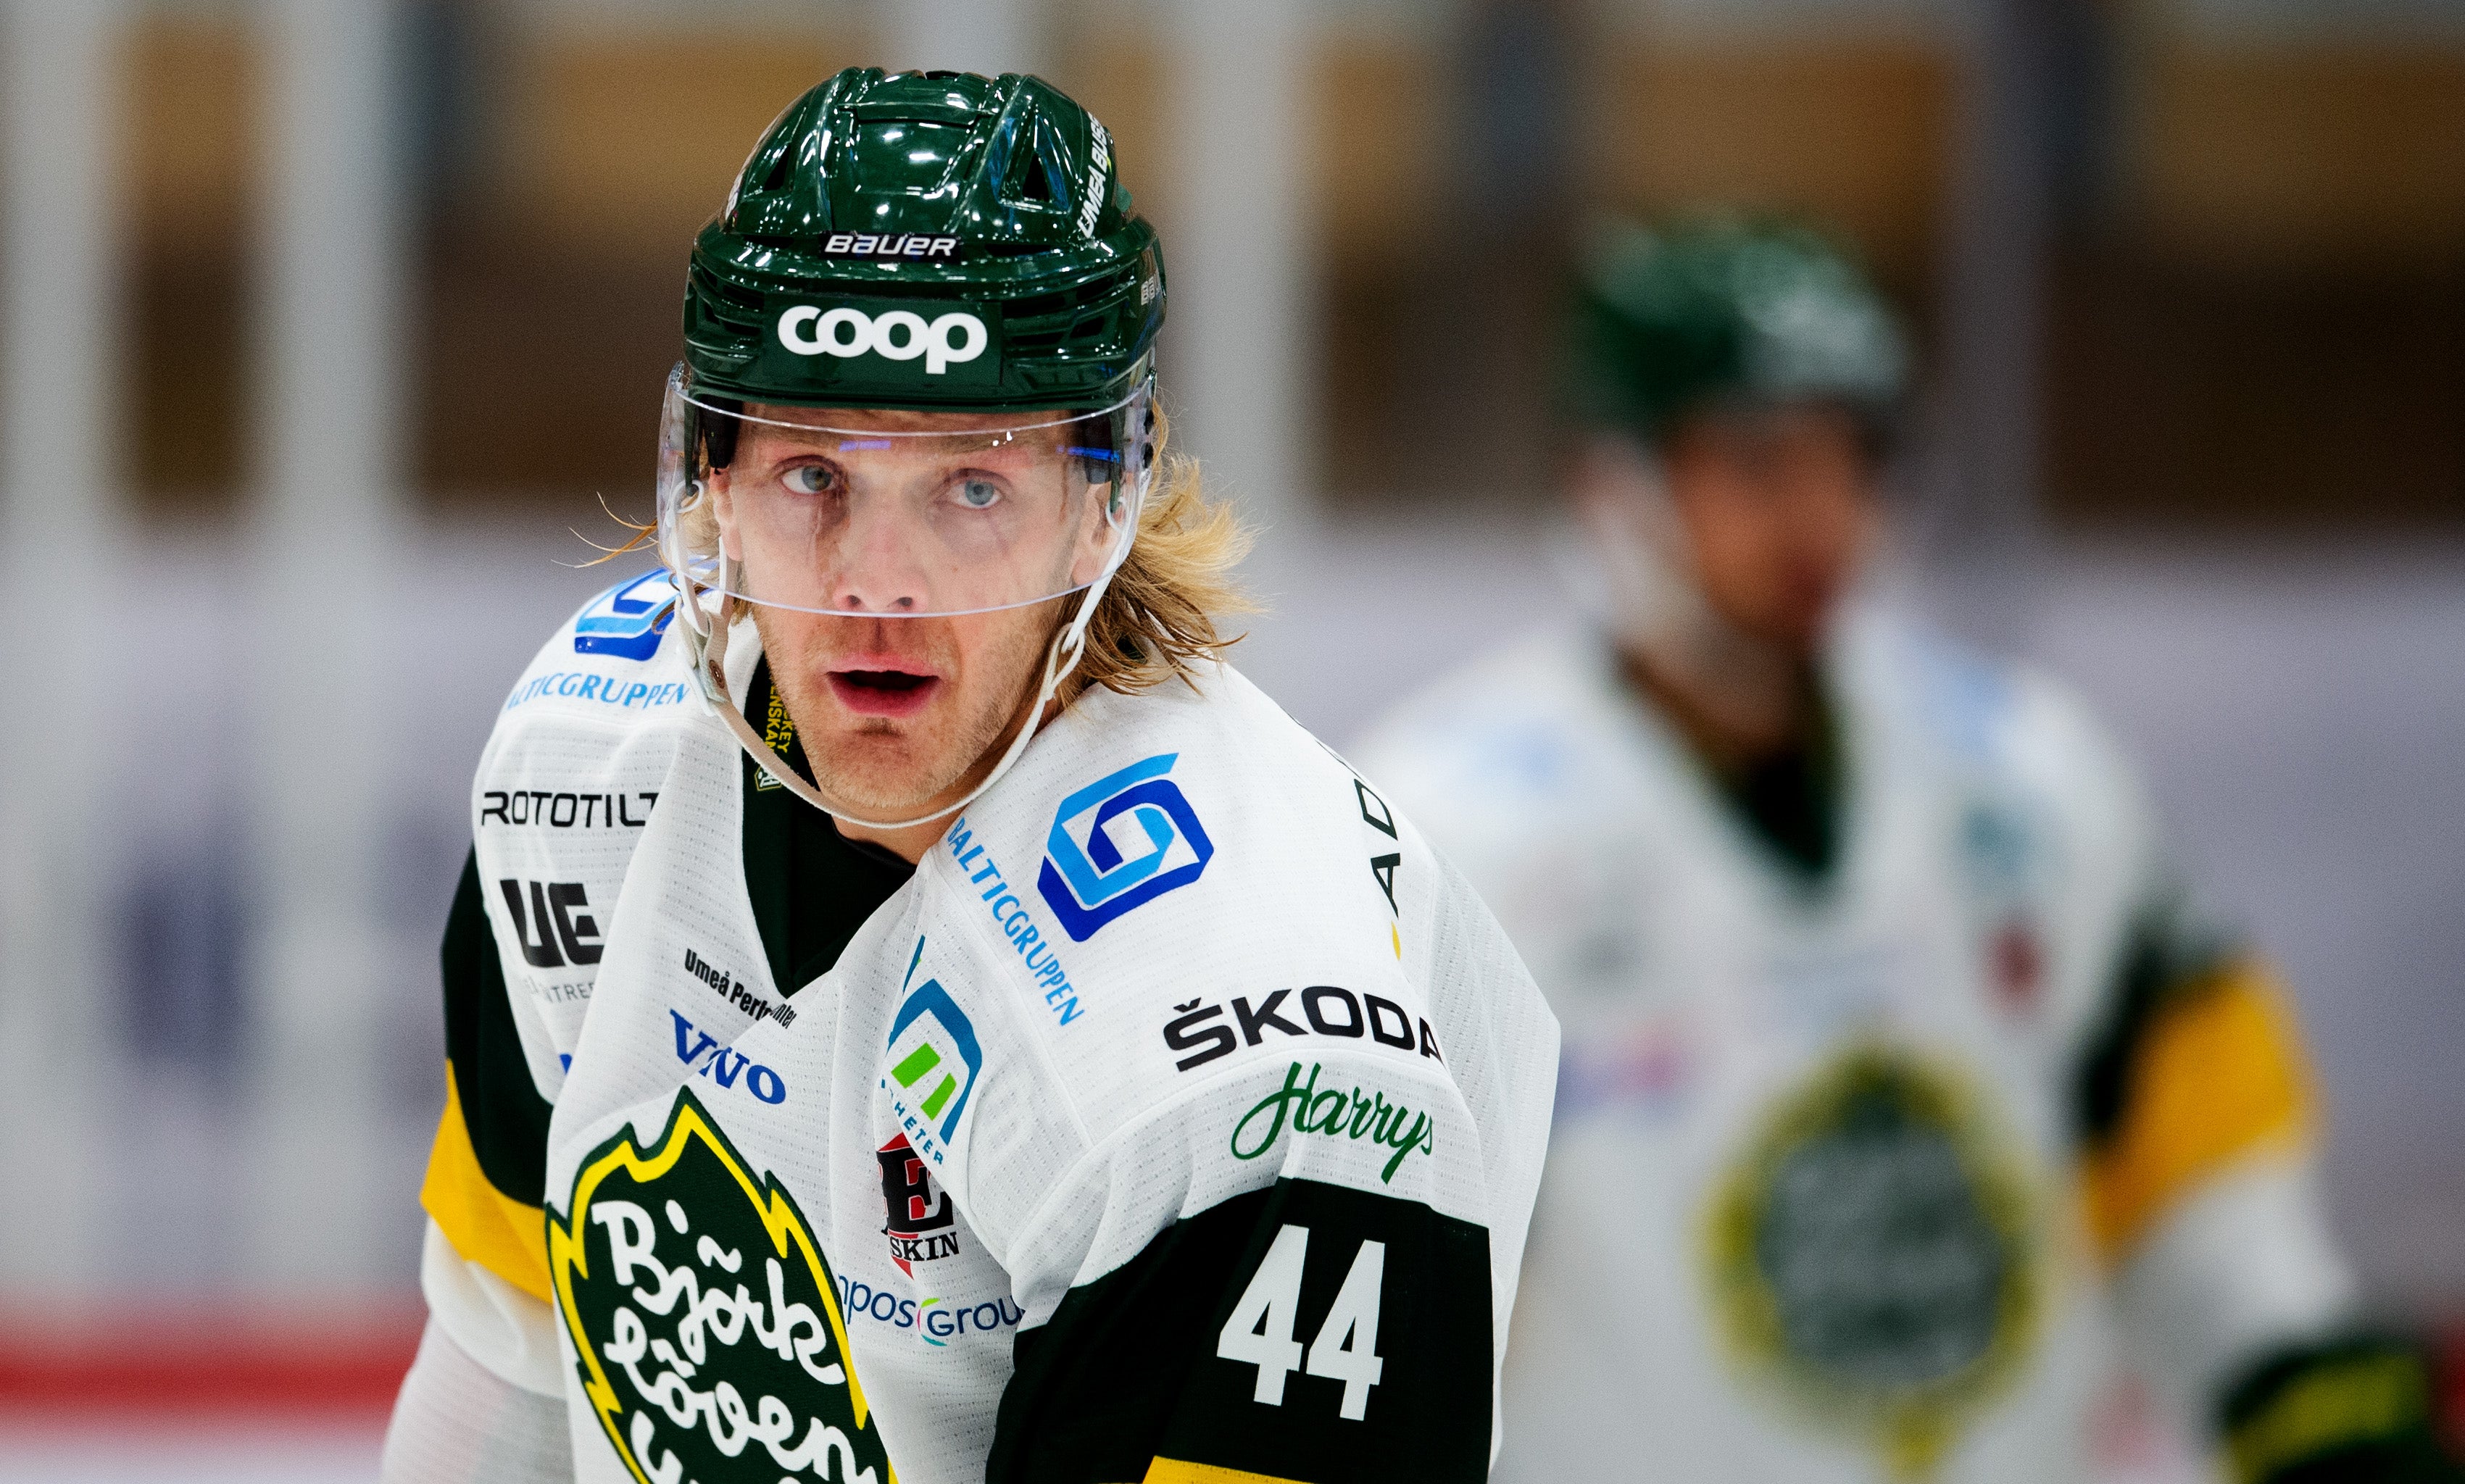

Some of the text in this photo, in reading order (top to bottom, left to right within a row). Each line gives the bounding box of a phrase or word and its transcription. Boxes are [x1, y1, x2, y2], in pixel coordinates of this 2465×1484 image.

[824, 233, 956, 257] BAUER
[778, 304, 988, 375] coop
[481, 791, 660, 828] ROTOTILT
[1353, 778, 1400, 920] AD
[947, 817, 1085, 1026] BALTICGRUPPEN
[684, 948, 730, 997] Umeå
[1163, 985, 1447, 1072] ŠKODA
[894, 1101, 944, 1165] HETER
[1231, 1061, 1433, 1185] Harrys
[1216, 1224, 1386, 1421] 44
